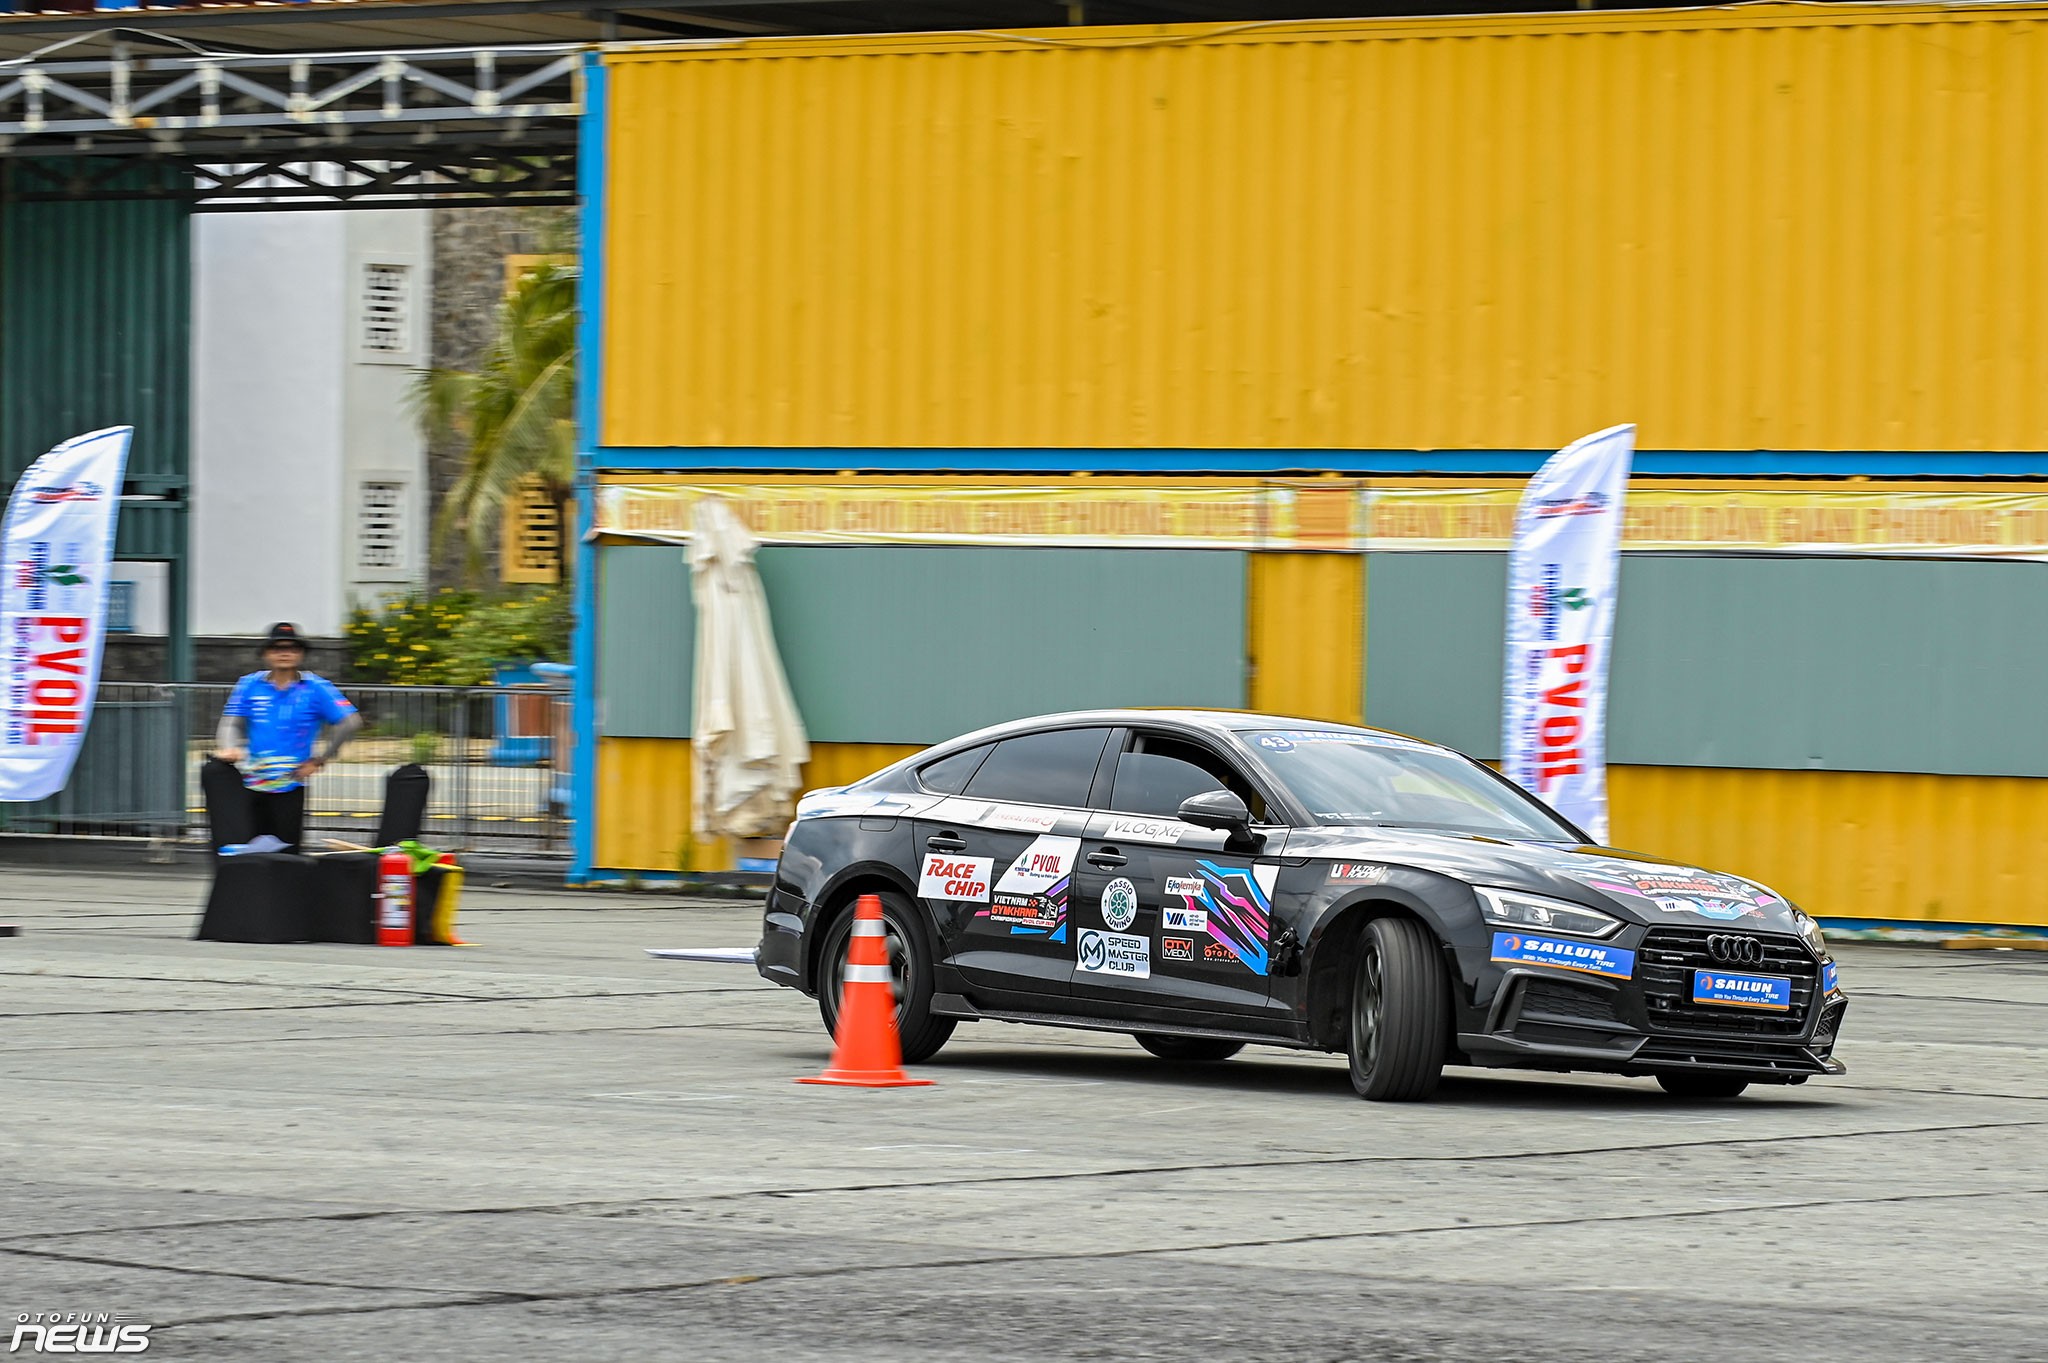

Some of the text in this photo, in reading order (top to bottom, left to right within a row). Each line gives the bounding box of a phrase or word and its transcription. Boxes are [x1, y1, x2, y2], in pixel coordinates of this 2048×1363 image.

[29, 616, 89, 745] PVOIL
[1537, 643, 1593, 792] PVOIL
[1260, 735, 1290, 749] 43
[926, 858, 976, 879] RACE
[1031, 853, 1061, 873] PVOIL
[944, 880, 986, 897] CHIP
[1108, 880, 1133, 896] PASSIO
[993, 894, 1029, 907] VIETNAM
[991, 904, 1039, 918] GYMKHANA
[1105, 913, 1132, 929] TUNING
[1107, 936, 1141, 949] SPEED
[1164, 939, 1192, 950] OTV
[1523, 939, 1607, 960] SAILUN
[1108, 949, 1149, 962] MASTER
[1165, 949, 1192, 960] MEDIA
[1108, 960, 1135, 972] CLUB
[1548, 956, 1571, 967] Through
[1571, 960, 1588, 970] Every
[1595, 959, 1617, 968] TIRE
[1714, 978, 1773, 993] SAILUN
